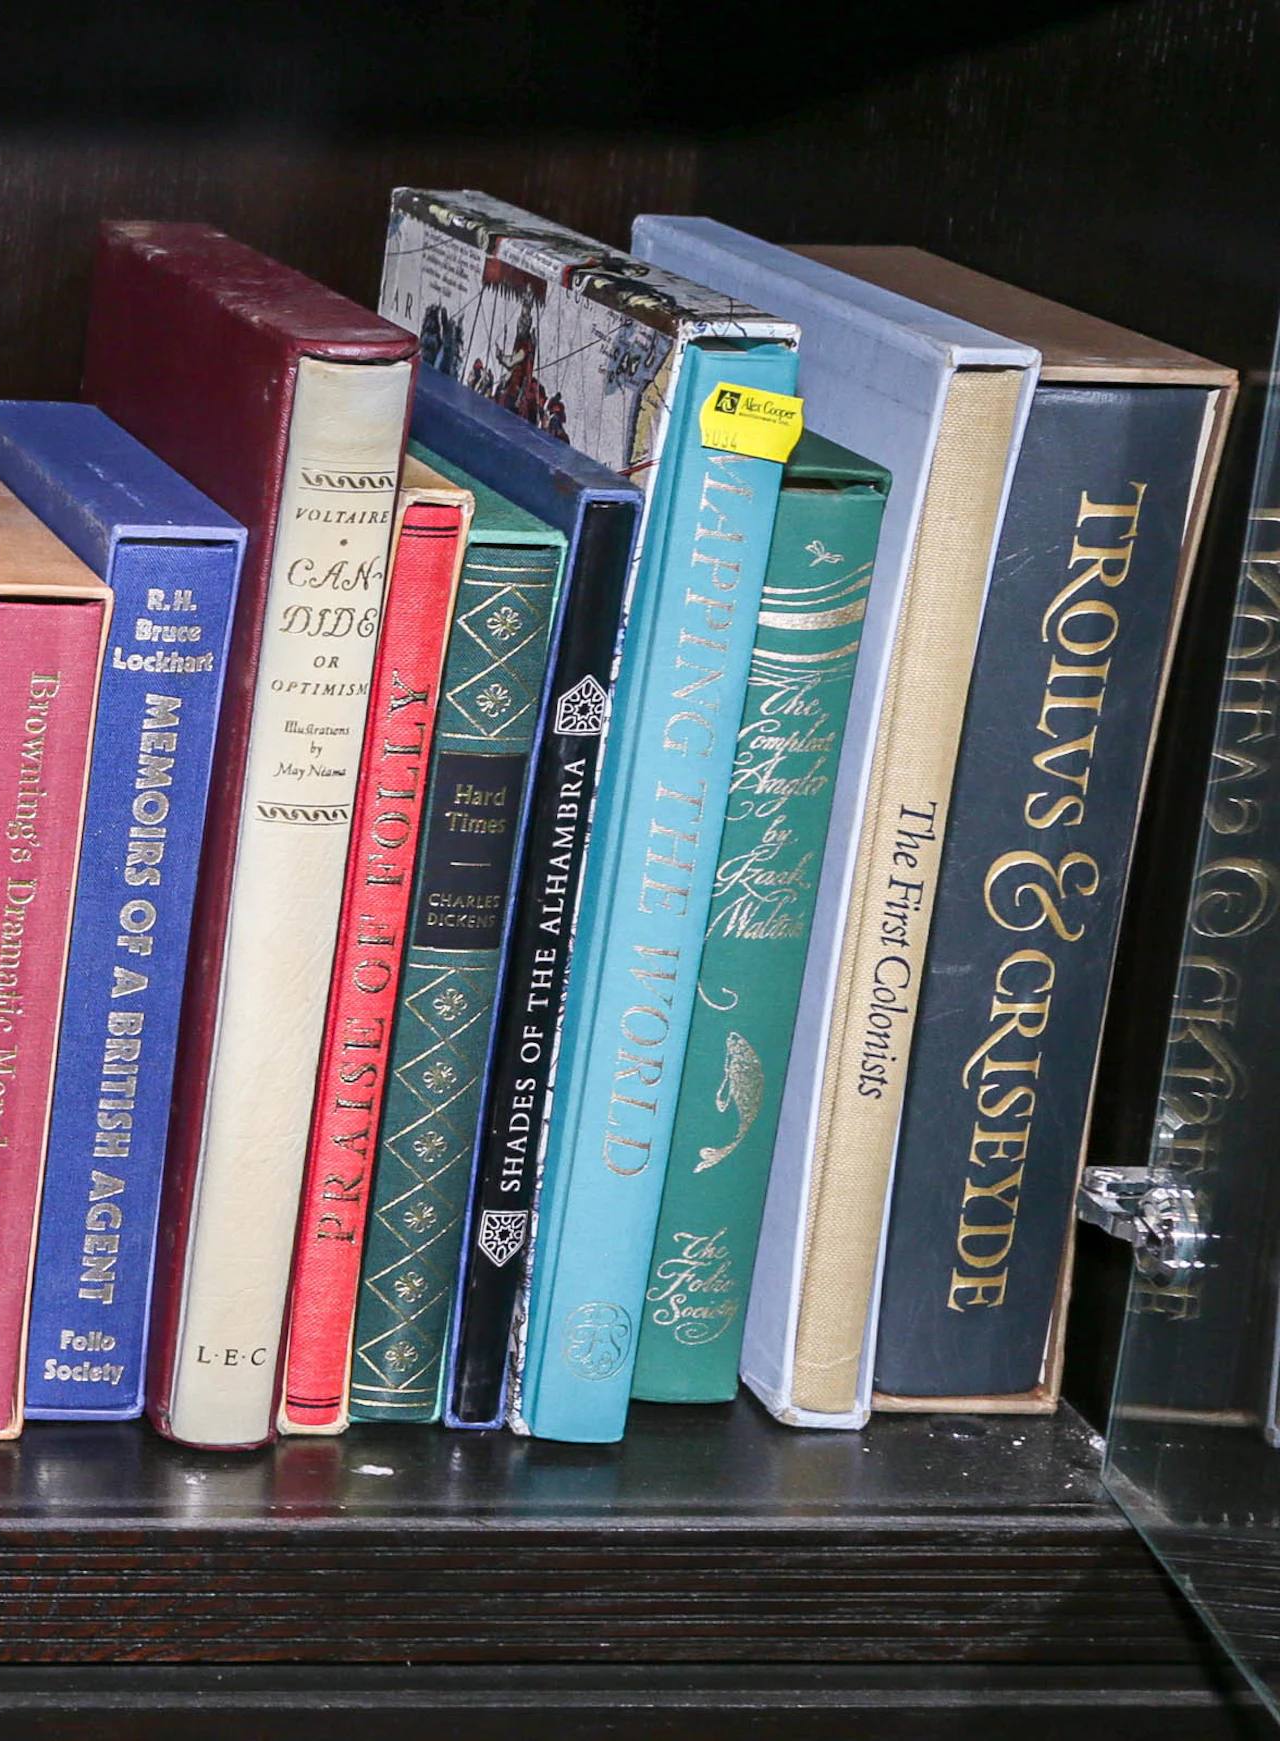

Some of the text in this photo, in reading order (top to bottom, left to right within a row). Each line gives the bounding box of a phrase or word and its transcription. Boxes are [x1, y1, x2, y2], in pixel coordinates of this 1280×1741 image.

[742, 396, 763, 412] Alex
[764, 400, 797, 420] Cooper
[294, 506, 391, 524] VOLTAIRE
[134, 618, 202, 643] Bruce
[278, 604, 379, 639] DIDE
[112, 646, 216, 674] Lockhart
[313, 655, 340, 670] OR
[270, 679, 368, 696] OPTIMISM
[749, 670, 823, 718] The
[283, 720, 351, 737] Illustrations
[310, 741, 323, 758] by
[5, 670, 62, 864] Browning's
[274, 763, 306, 783] May
[454, 783, 508, 807] Hard
[729, 755, 831, 820] Angler
[444, 810, 507, 835] Times
[601, 454, 756, 1177] MAPPING THE WORLD
[762, 814, 793, 846] by
[427, 892, 500, 909] CHARLES
[946, 480, 1149, 1314] TROILVS & CRISEYDE
[426, 912, 497, 929] DICKENS
[315, 667, 432, 1248] PRAISE OF FOLLY
[858, 800, 939, 1100] The First Colonists
[500, 757, 588, 1194] SHADES OF THE ALHAMBRA
[78, 692, 183, 1305] MEMOIRS OF A BRITISH AGENT
[673, 1226, 731, 1262] The
[647, 1258, 735, 1302] Folio
[652, 1297, 737, 1346] Society
[60, 1329, 116, 1352] Folio
[43, 1359, 125, 1386] Society
